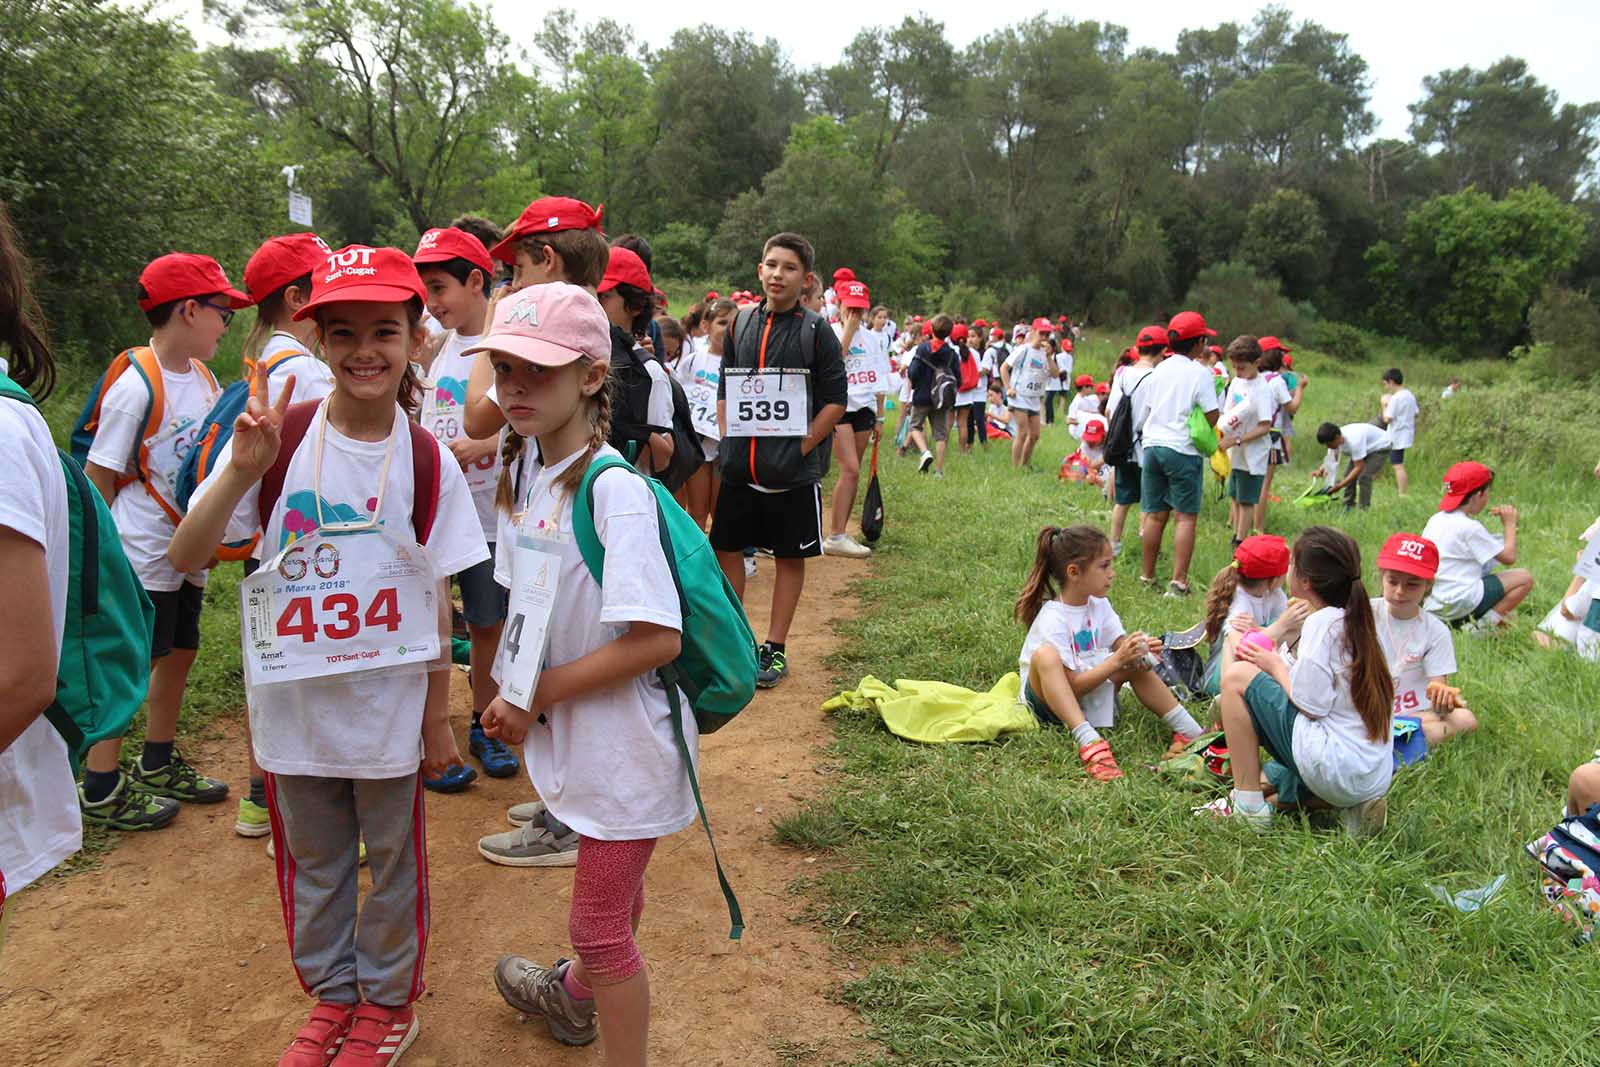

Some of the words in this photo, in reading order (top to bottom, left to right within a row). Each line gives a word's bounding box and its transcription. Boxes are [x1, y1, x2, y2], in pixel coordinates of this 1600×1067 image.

[327, 248, 376, 272] TOT
[325, 269, 342, 283] Sant
[346, 267, 375, 276] Cugat
[504, 299, 539, 327] M
[846, 371, 877, 385] 468
[738, 400, 790, 421] 539
[1401, 540, 1424, 554] TOT
[278, 543, 340, 581] 60
[286, 583, 316, 593] Marxa
[276, 587, 402, 643] 434
[506, 613, 526, 663] 4
